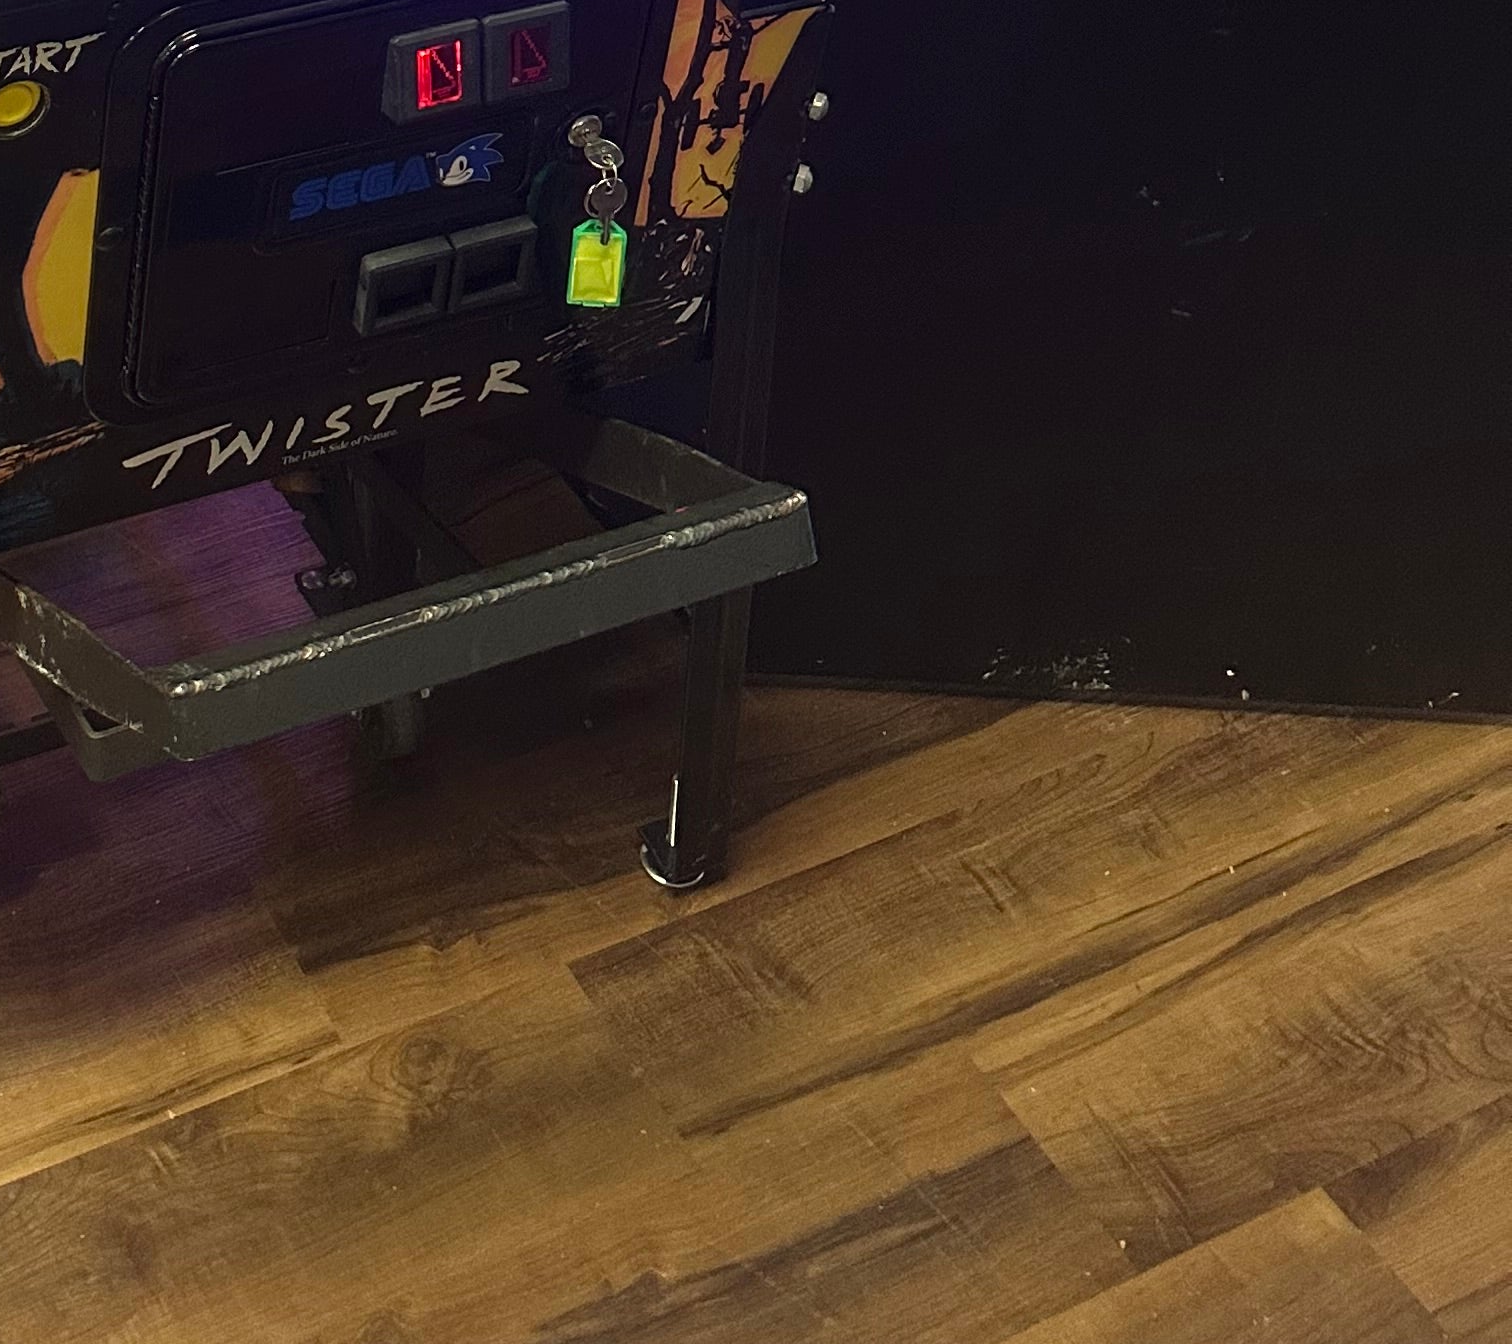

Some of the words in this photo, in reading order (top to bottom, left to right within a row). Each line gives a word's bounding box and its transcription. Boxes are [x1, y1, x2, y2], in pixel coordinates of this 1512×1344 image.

[288, 154, 432, 222] SEGA
[121, 358, 530, 491] TWISTER
[281, 450, 301, 466] The
[302, 443, 326, 460] Dark
[327, 437, 350, 454] Side
